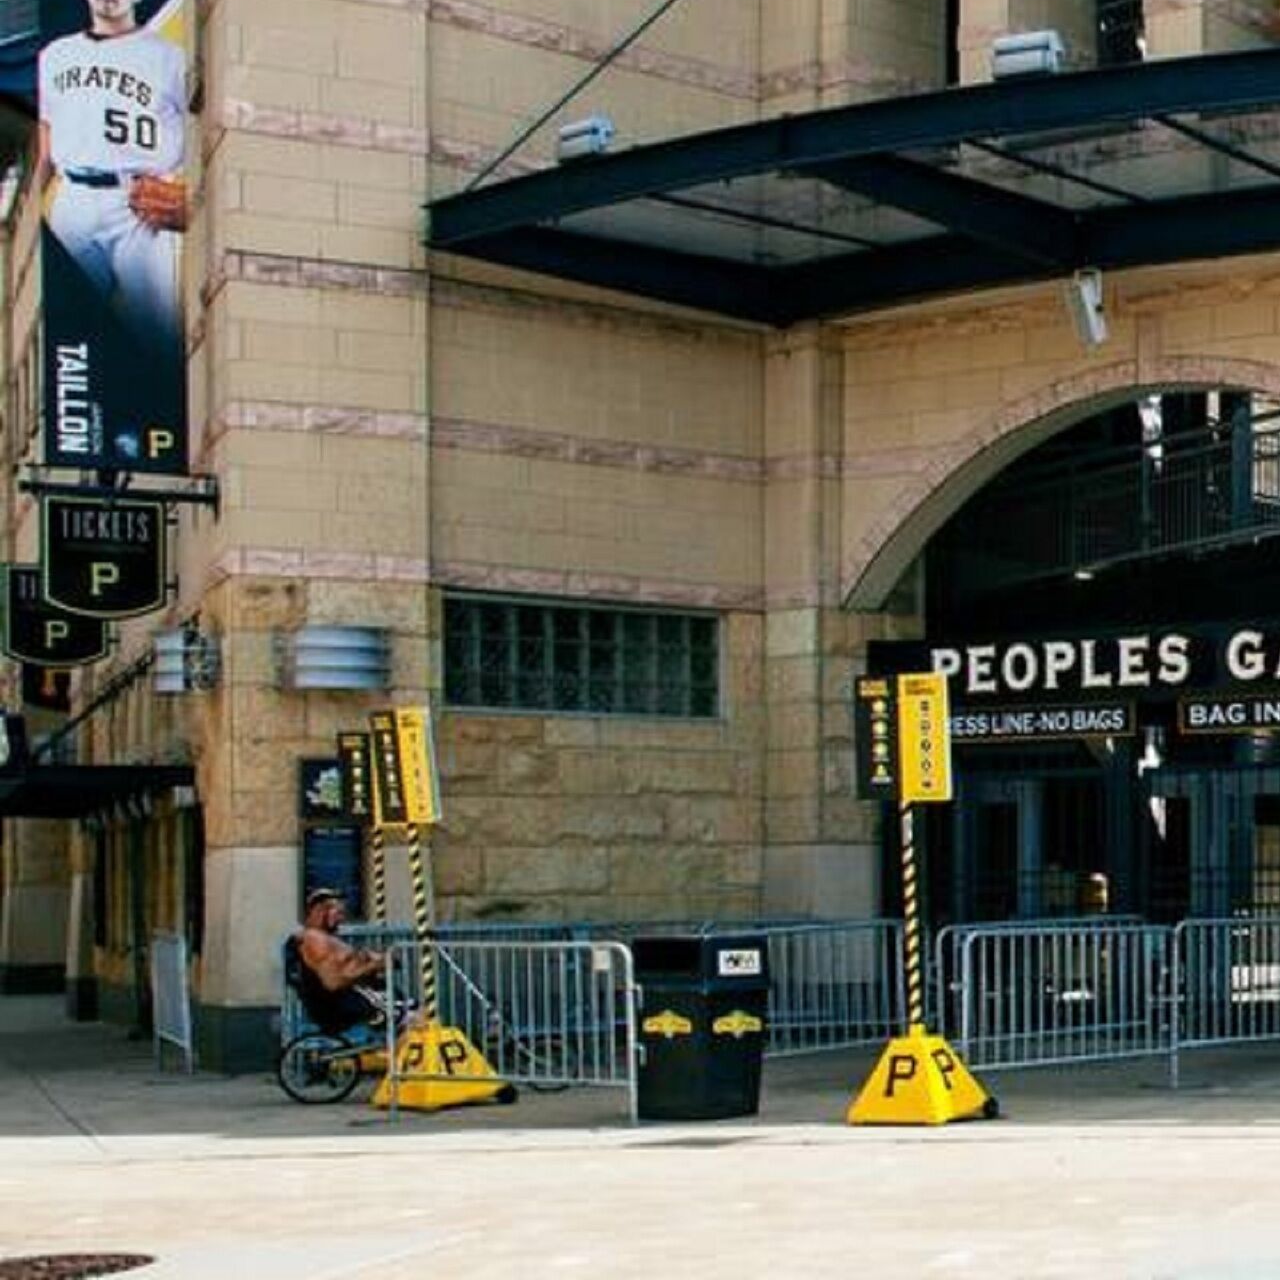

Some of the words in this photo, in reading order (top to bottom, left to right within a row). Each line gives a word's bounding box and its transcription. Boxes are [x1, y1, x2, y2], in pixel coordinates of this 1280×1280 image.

[54, 65, 152, 106] IRATES
[104, 108, 157, 151] 50
[56, 343, 89, 453] TAILLON
[149, 430, 174, 458] P
[61, 510, 149, 541] TICKETS
[91, 562, 119, 595] P
[45, 621, 69, 648] P
[931, 635, 1191, 693] PEOPLES
[1072, 709, 1124, 730] BAGS
[1189, 703, 1247, 725] BAG
[440, 1039, 467, 1075] P
[930, 1048, 954, 1090] P
[885, 1055, 916, 1096] P
